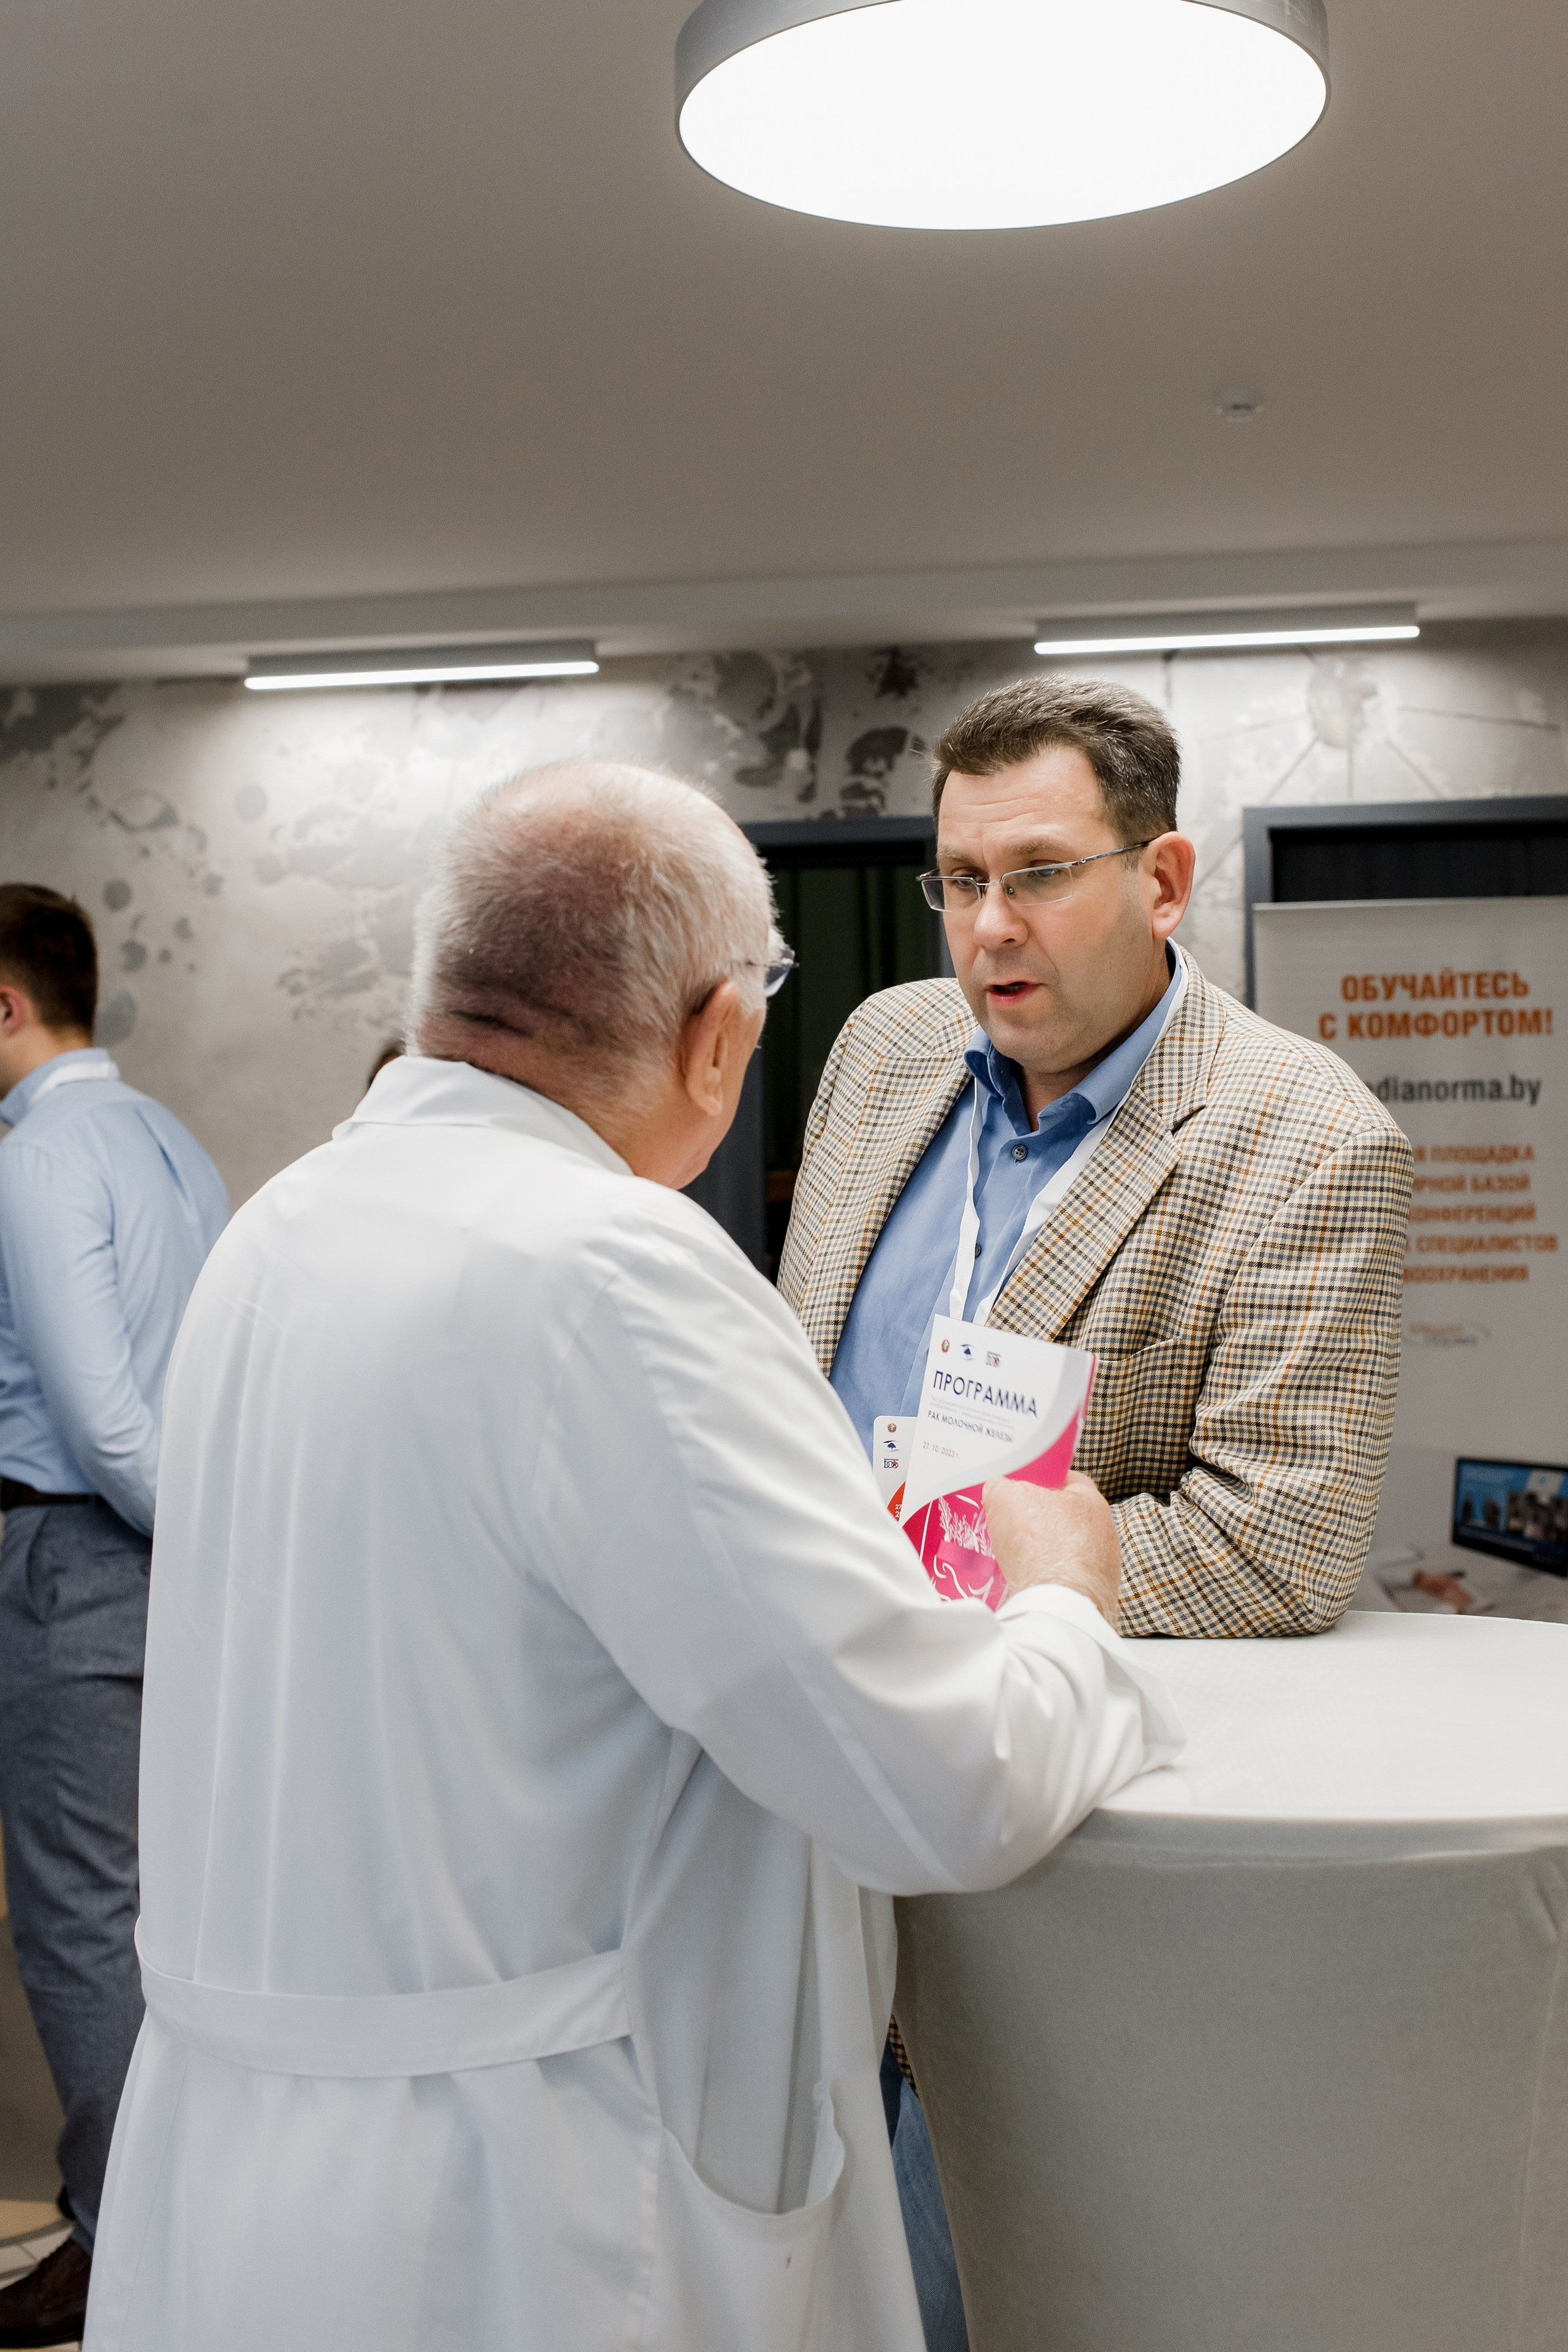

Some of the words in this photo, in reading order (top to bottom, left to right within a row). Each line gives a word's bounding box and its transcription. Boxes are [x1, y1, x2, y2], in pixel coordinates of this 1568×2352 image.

[1341, 967, 1529, 1001] ОБУЧАЙТЕСЬ
[1318, 1012, 1337, 1039] С
[1348, 1008, 1553, 1039] КОМФОРТОМ!
[1431, 1144, 1534, 1164] ПЛОЩАДКА
[1471, 1172, 1531, 1193] БАЗОЙ
[1415, 1233, 1559, 1254] СПЕЦИАЛИСТОВ
[933, 1370, 1038, 1418] ПРОГРАММА
[927, 1410, 940, 1422] РАК
[941, 1414, 984, 1434] МОЛОЧНОЙ
